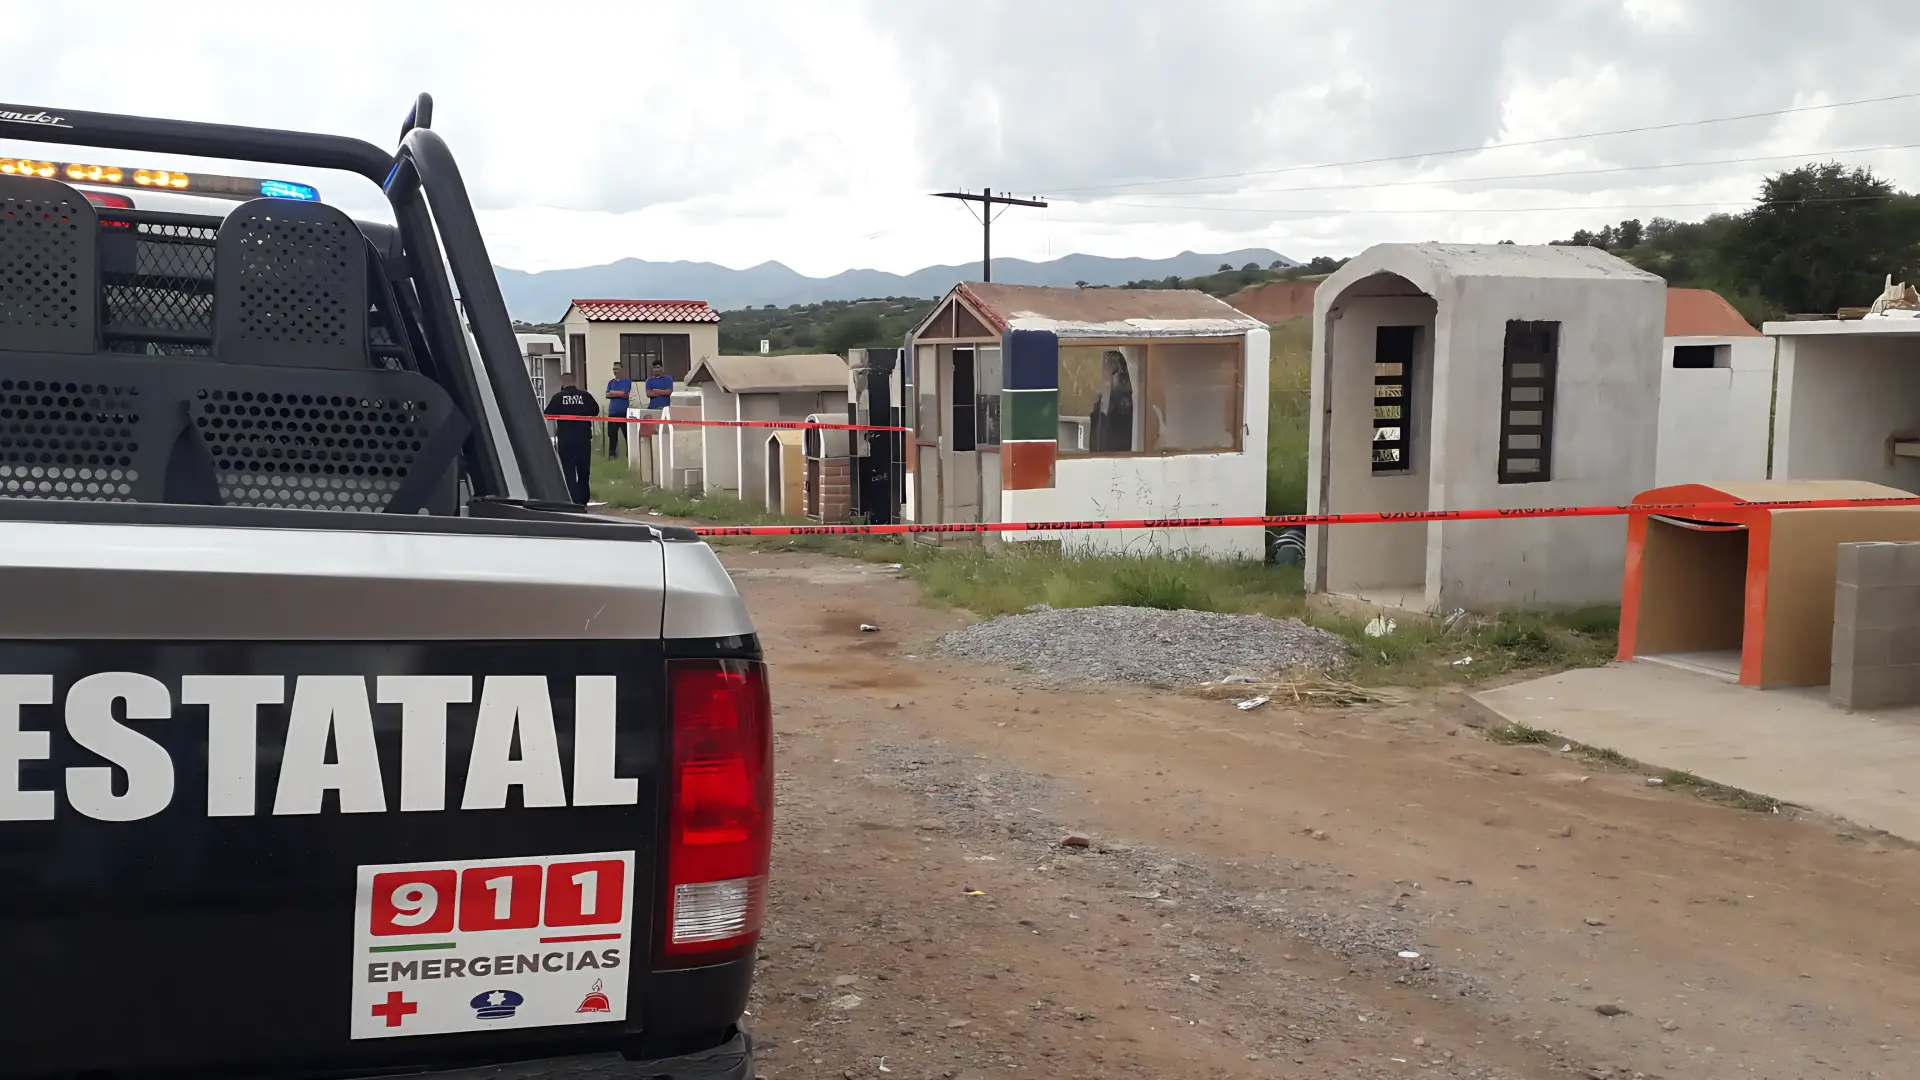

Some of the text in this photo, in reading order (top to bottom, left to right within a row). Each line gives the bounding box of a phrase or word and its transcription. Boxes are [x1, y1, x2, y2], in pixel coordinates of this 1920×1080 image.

[0, 671, 639, 822] ESTATAL
[390, 870, 598, 927] 911
[367, 948, 621, 983] EMERGENCIAS
